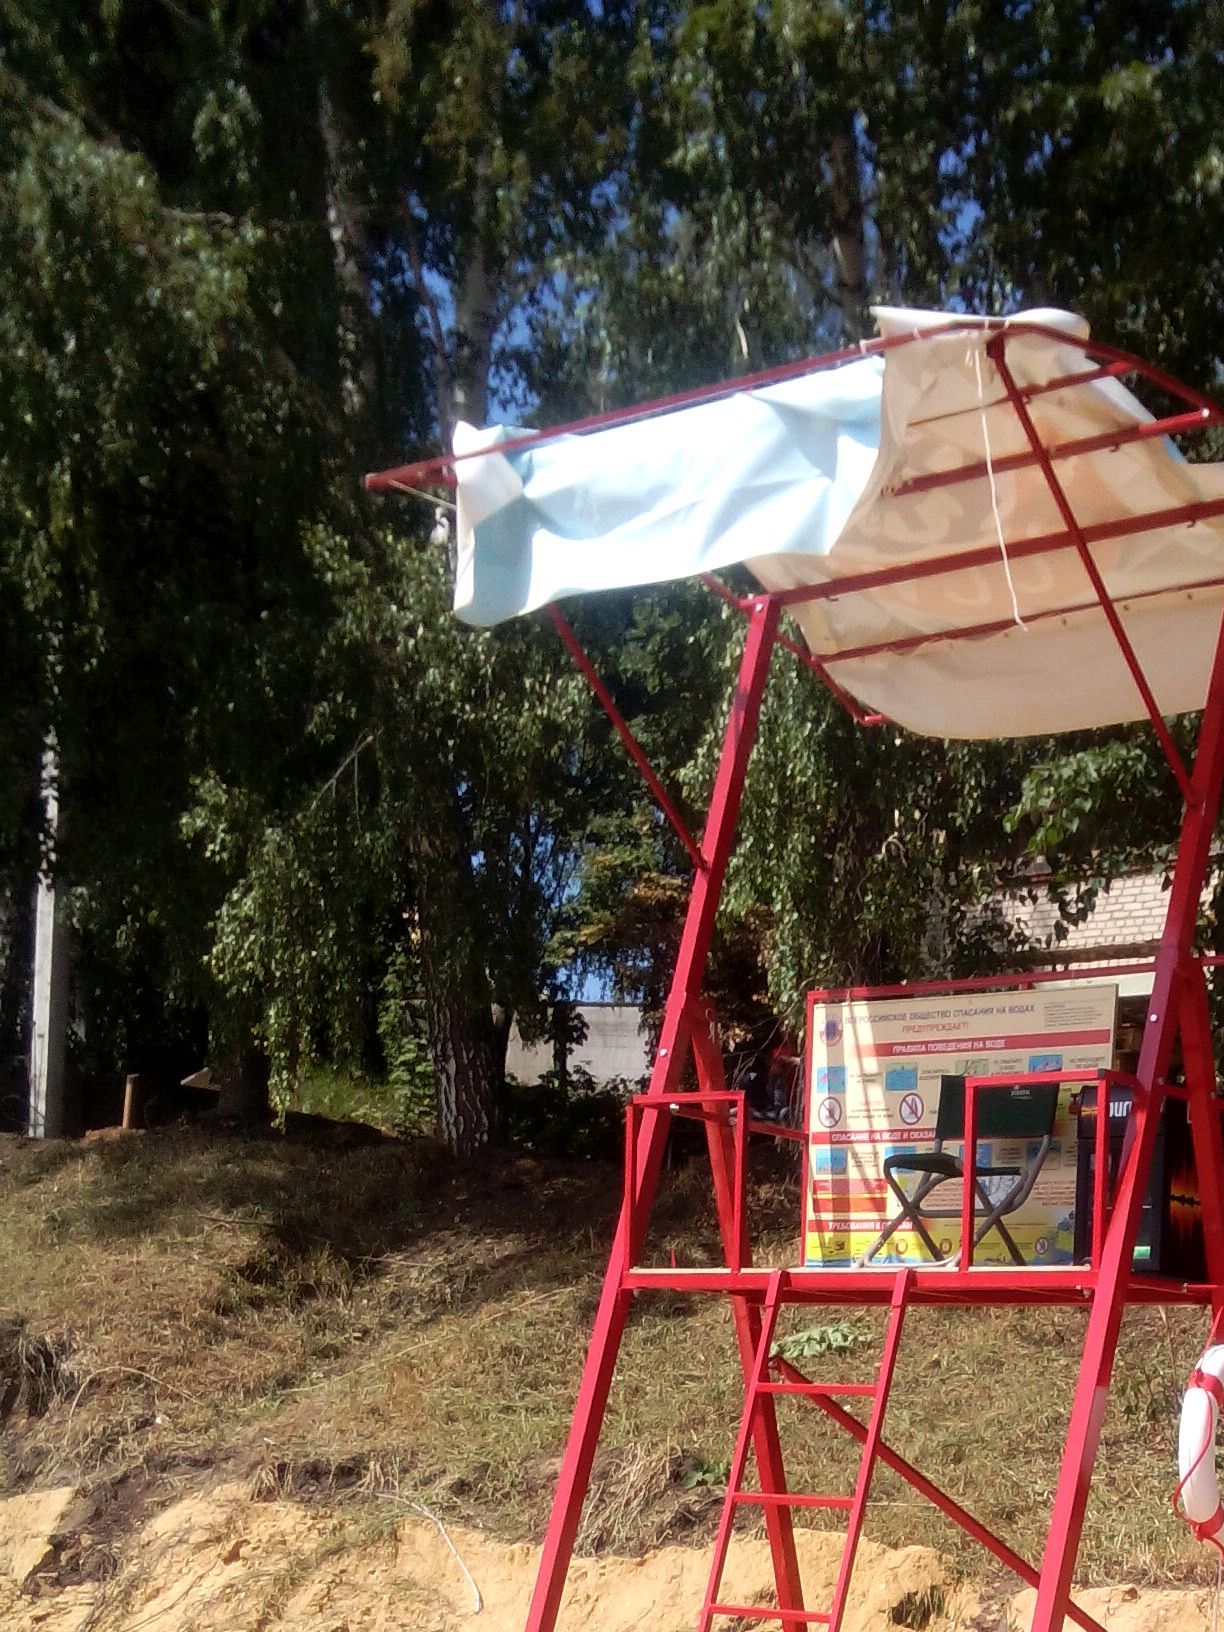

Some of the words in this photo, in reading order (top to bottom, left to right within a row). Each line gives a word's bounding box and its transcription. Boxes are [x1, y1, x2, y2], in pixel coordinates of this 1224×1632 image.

[909, 1010, 951, 1020] ОБЩЕСТВО
[953, 1007, 994, 1018] СПАСАНИЯ
[996, 1006, 1007, 1015] НА
[1008, 1004, 1035, 1014] ВОДАХ
[892, 1044, 926, 1054] ПРАВИЛА
[927, 1041, 972, 1052] ПОВЕДЕНИЯ
[973, 1040, 984, 1049] НА
[871, 1131, 880, 1141] НА
